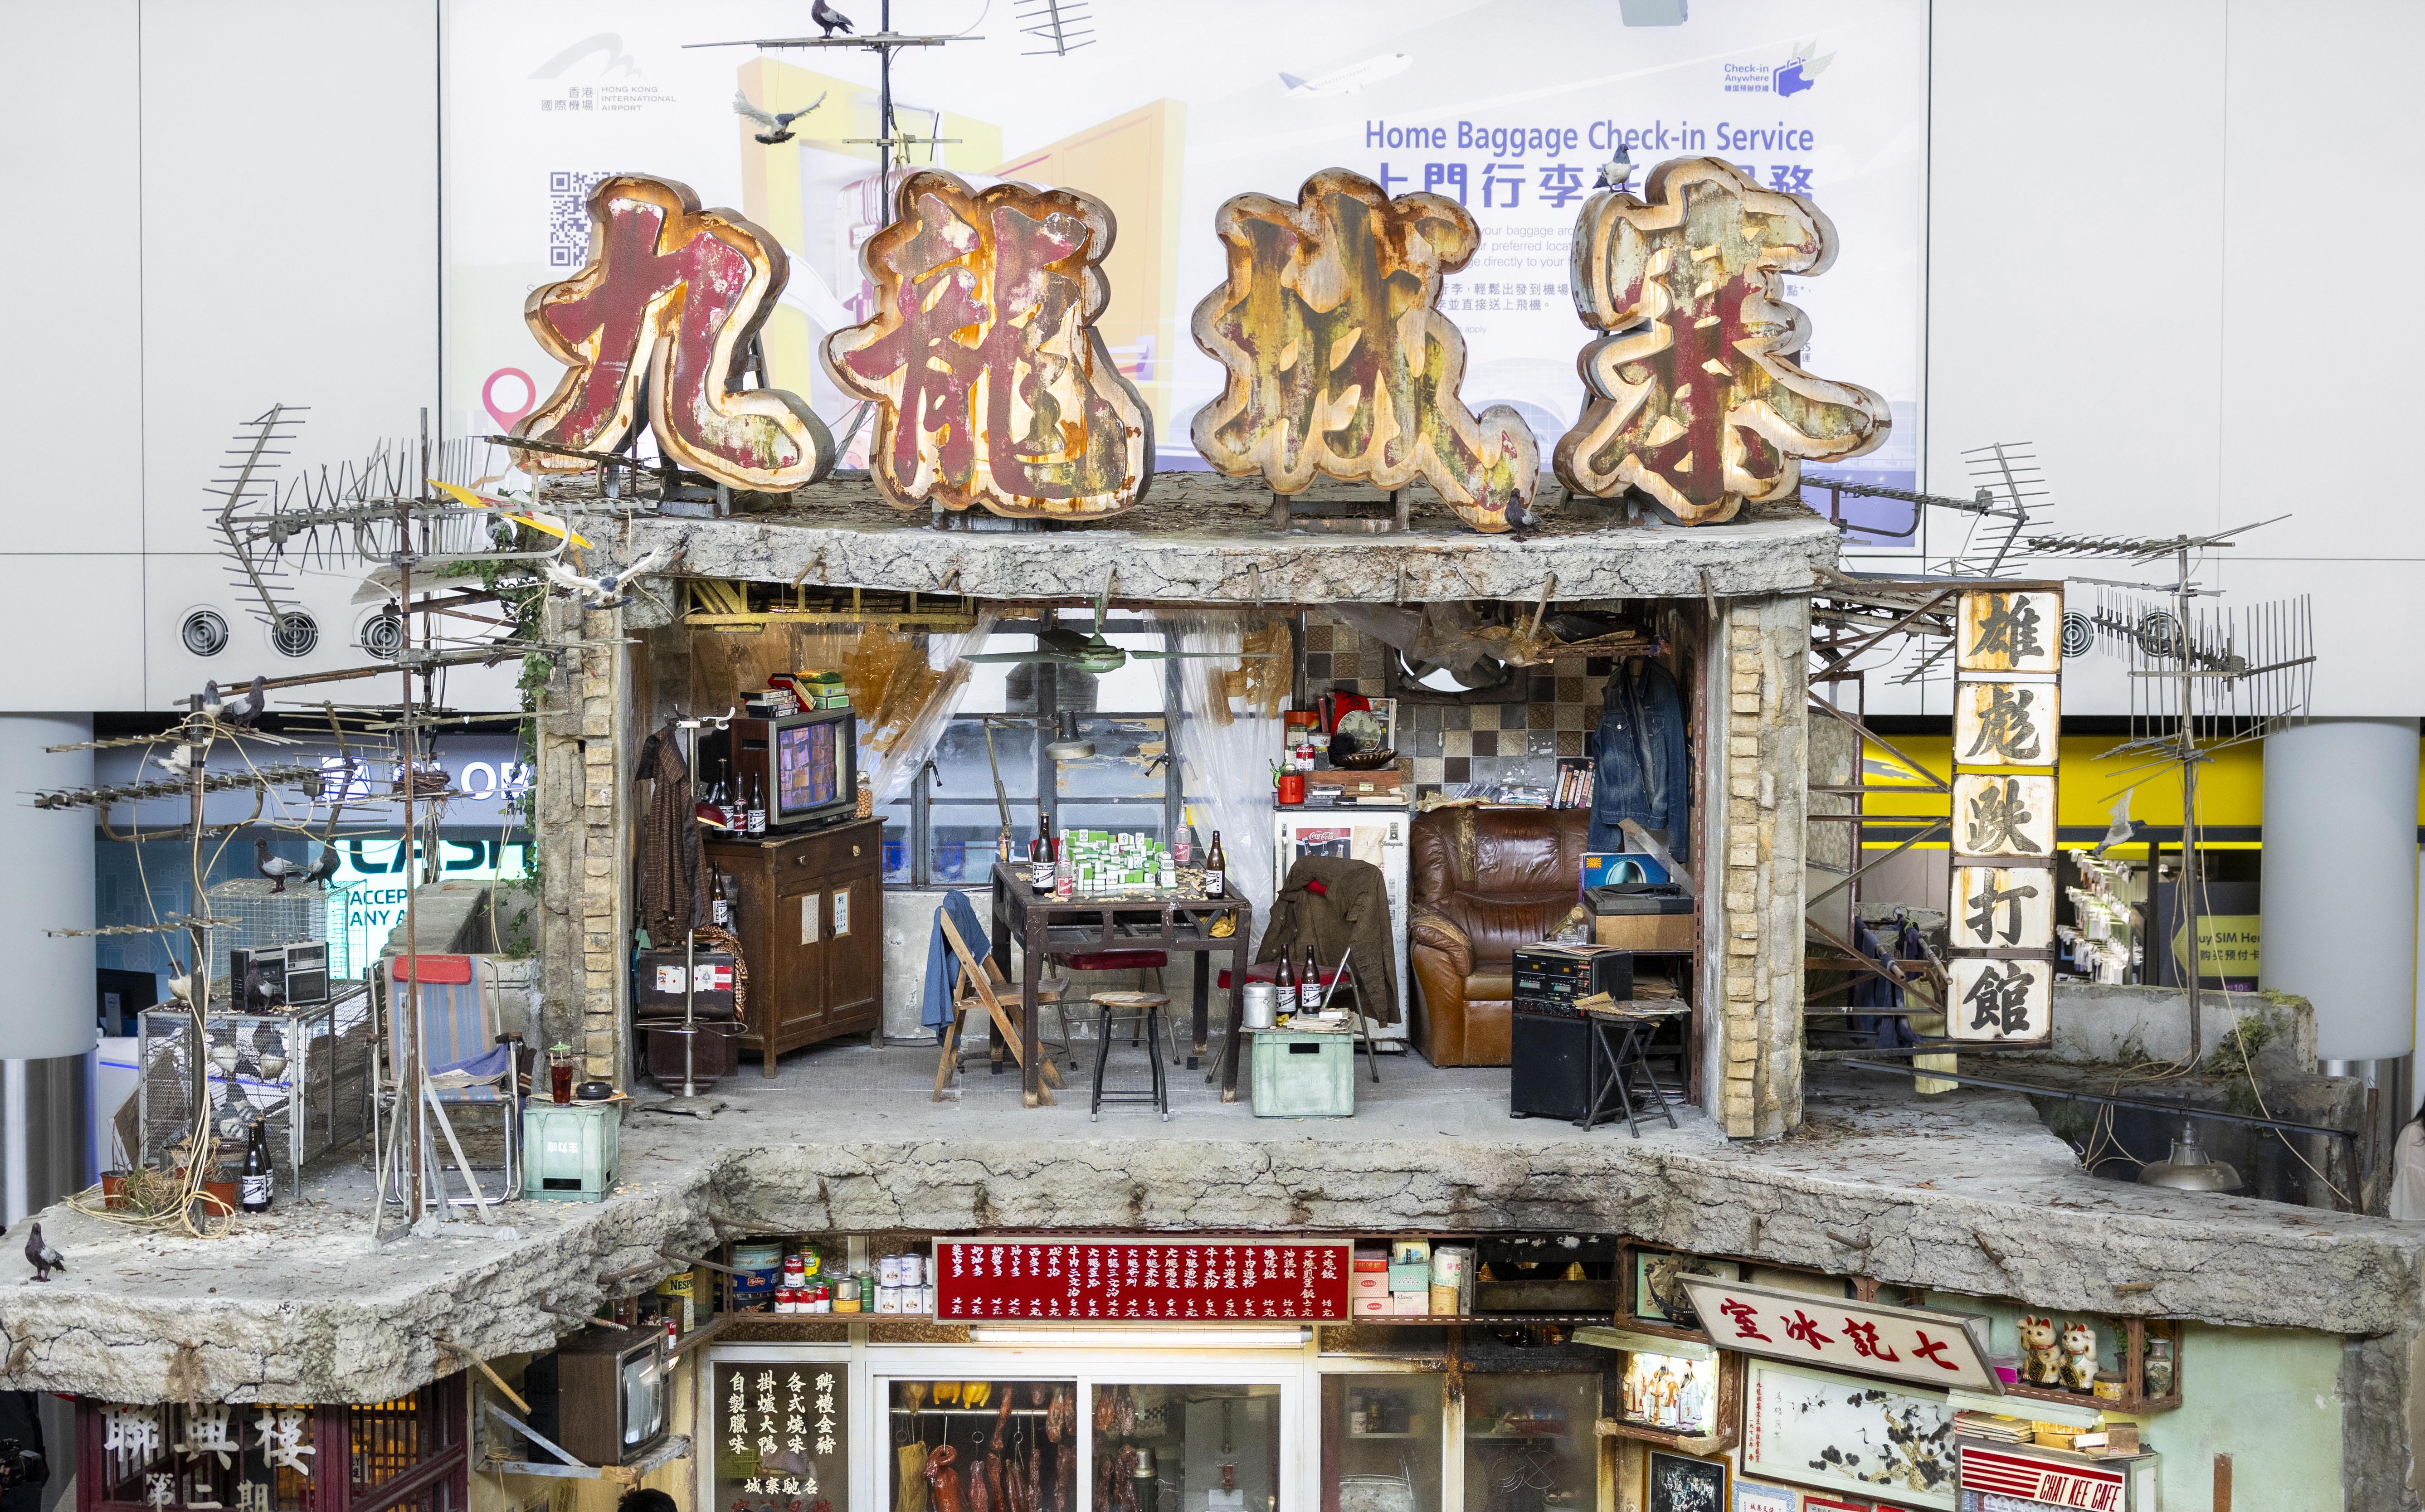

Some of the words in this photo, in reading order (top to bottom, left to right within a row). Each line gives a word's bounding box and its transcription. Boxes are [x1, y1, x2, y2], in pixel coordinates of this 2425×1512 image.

[1724, 63, 1769, 73] Check-in
[1724, 74, 1769, 83] Anywhere
[568, 86, 594, 98] 香港
[541, 99, 594, 111] 國際機場
[1366, 120, 1446, 149] Home
[1458, 121, 1578, 157] Baggage
[1589, 120, 1705, 150] Check-in
[1717, 121, 1814, 151] Service
[1506, 225, 1553, 238] baggage
[1491, 241, 1542, 254] preferred
[1484, 256, 1522, 269] directly
[1527, 257, 1537, 266] to
[1541, 259, 1564, 269] your
[1465, 325, 1487, 335] apply
[1962, 594, 2045, 1037] 雄彪跌打館
[350, 910, 390, 926] ANY
[2216, 932, 2237, 943] SIM
[1321, 1249, 1337, 1279] 叉燒飯
[727, 1371, 749, 1454] 自製臘味
[756, 1369, 778, 1457] 掛爐大鴨
[785, 1371, 807, 1454] 各式燒味
[814, 1371, 837, 1454] 聘禮金豬
[744, 1476, 818, 1495] 城寨馳名
[2040, 1474, 2069, 1503] CHAT
[2070, 1479, 2092, 1507] KEE
[2091, 1483, 2122, 1512] CAFE
